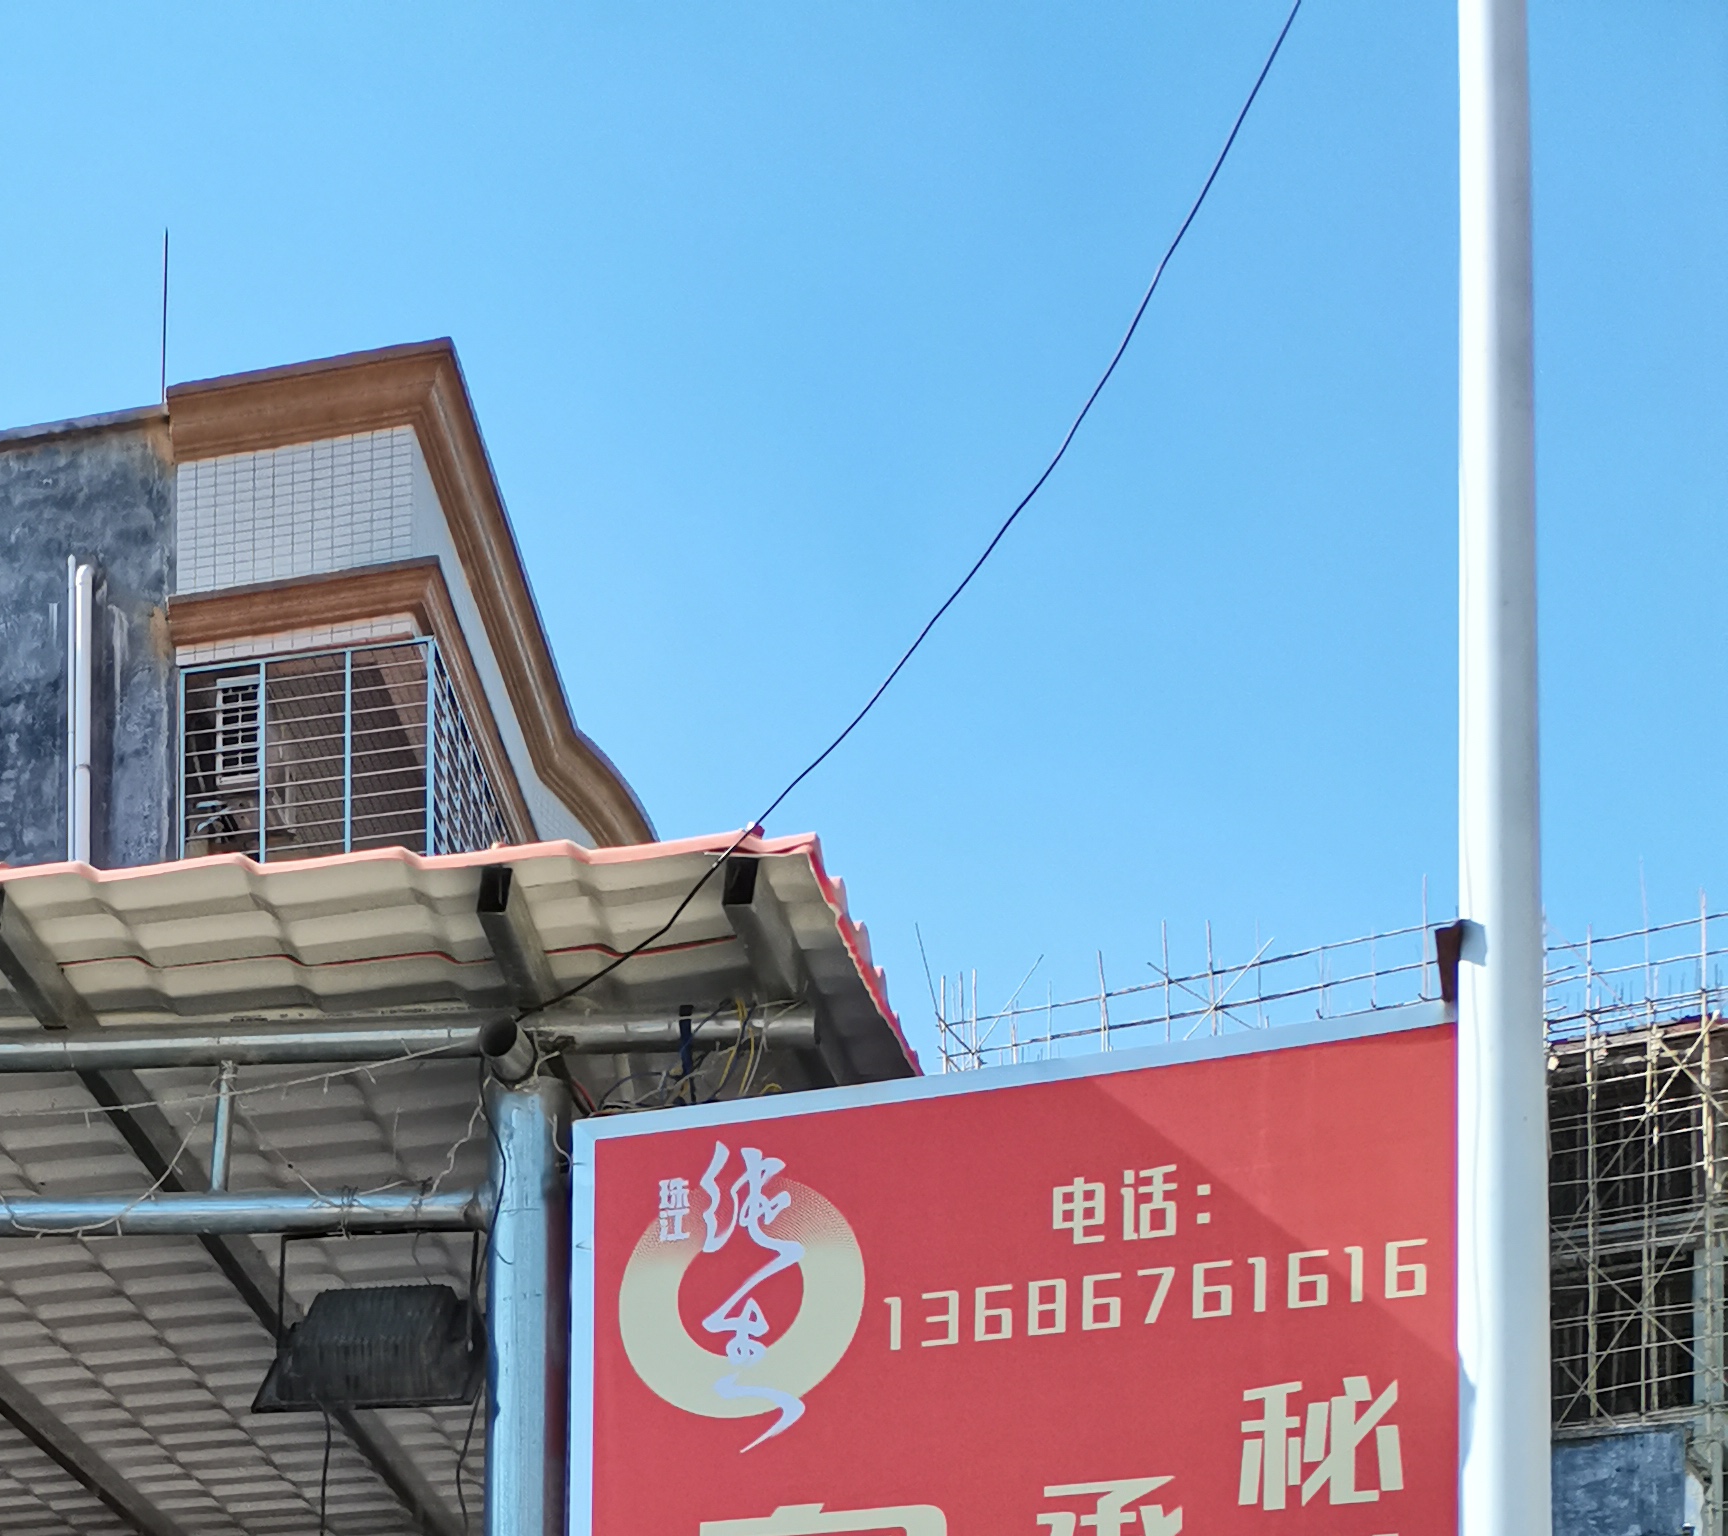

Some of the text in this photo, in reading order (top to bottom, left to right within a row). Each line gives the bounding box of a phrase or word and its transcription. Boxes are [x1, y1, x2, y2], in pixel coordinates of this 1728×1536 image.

[658, 1176, 690, 1241] 珠江
[1050, 1163, 1214, 1246] 电话：
[882, 1237, 1429, 1352] 13686761616
